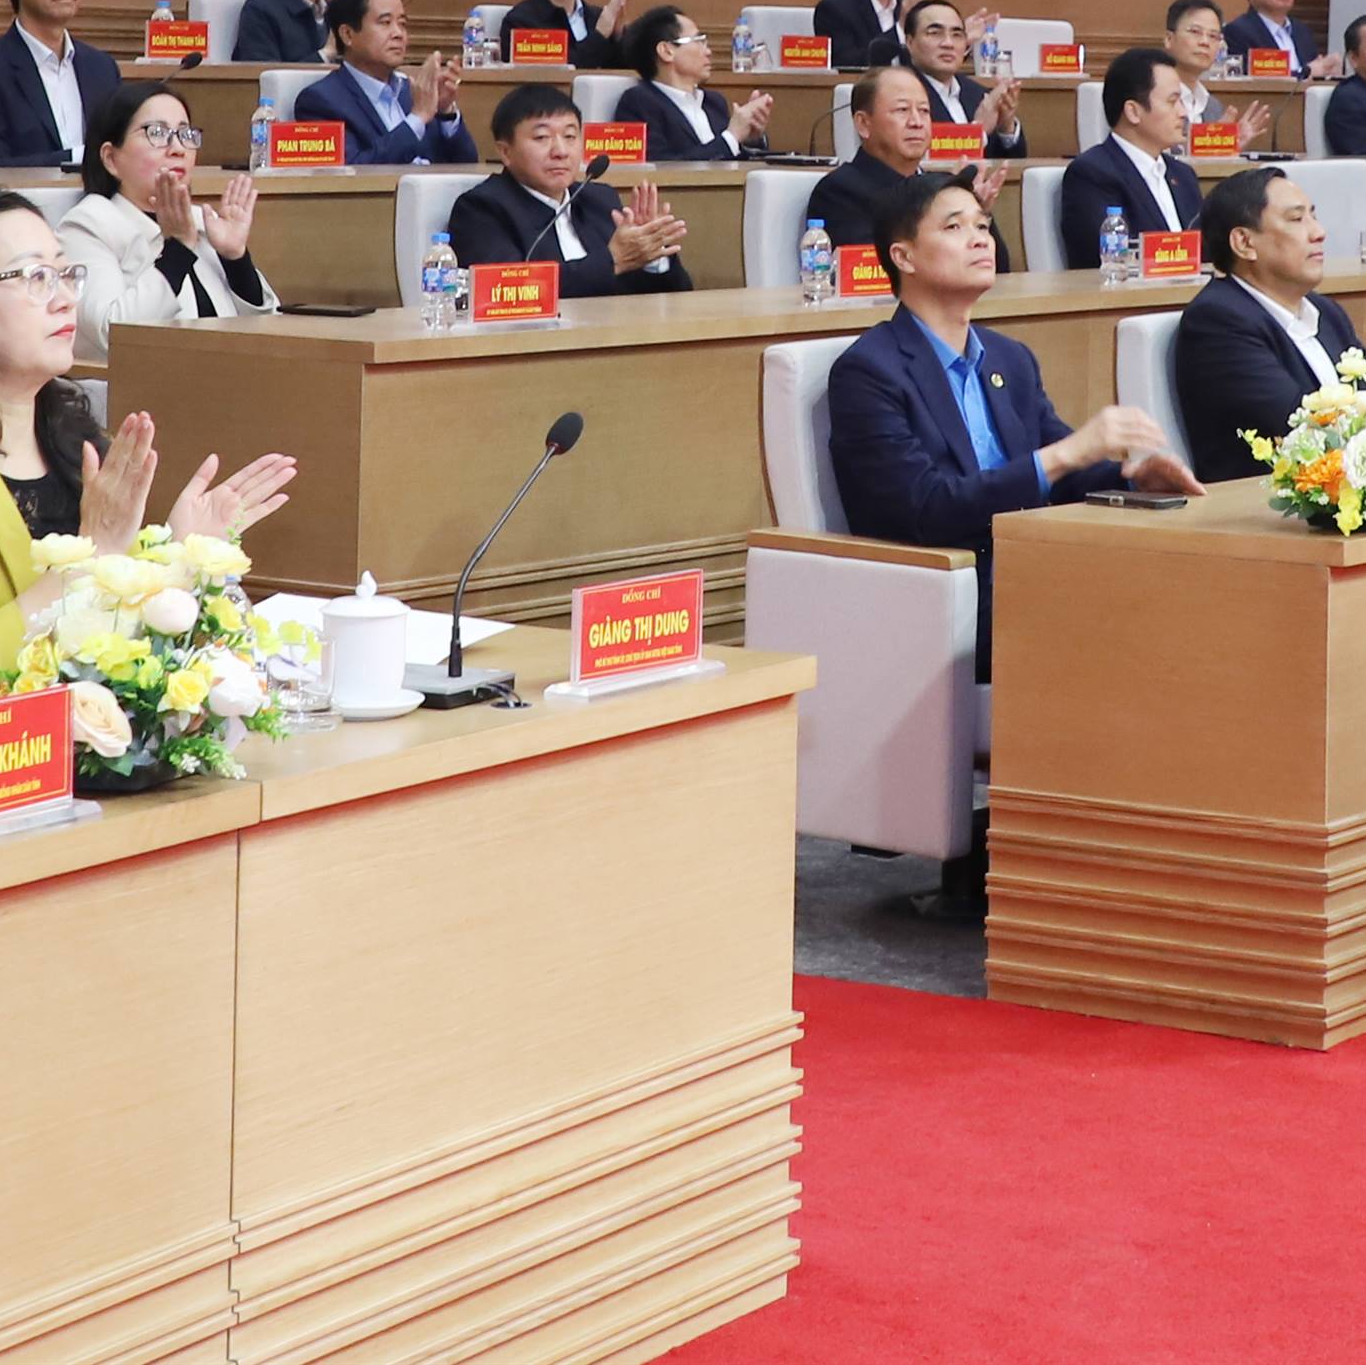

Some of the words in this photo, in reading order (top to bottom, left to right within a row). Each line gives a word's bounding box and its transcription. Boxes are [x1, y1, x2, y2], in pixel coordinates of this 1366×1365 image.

[492, 284, 501, 302] LÝ
[503, 287, 516, 305] THỊ
[518, 285, 539, 300] VINH
[589, 616, 631, 648] GIÀNG
[634, 616, 652, 645] THỊ
[655, 610, 689, 637] DUNG
